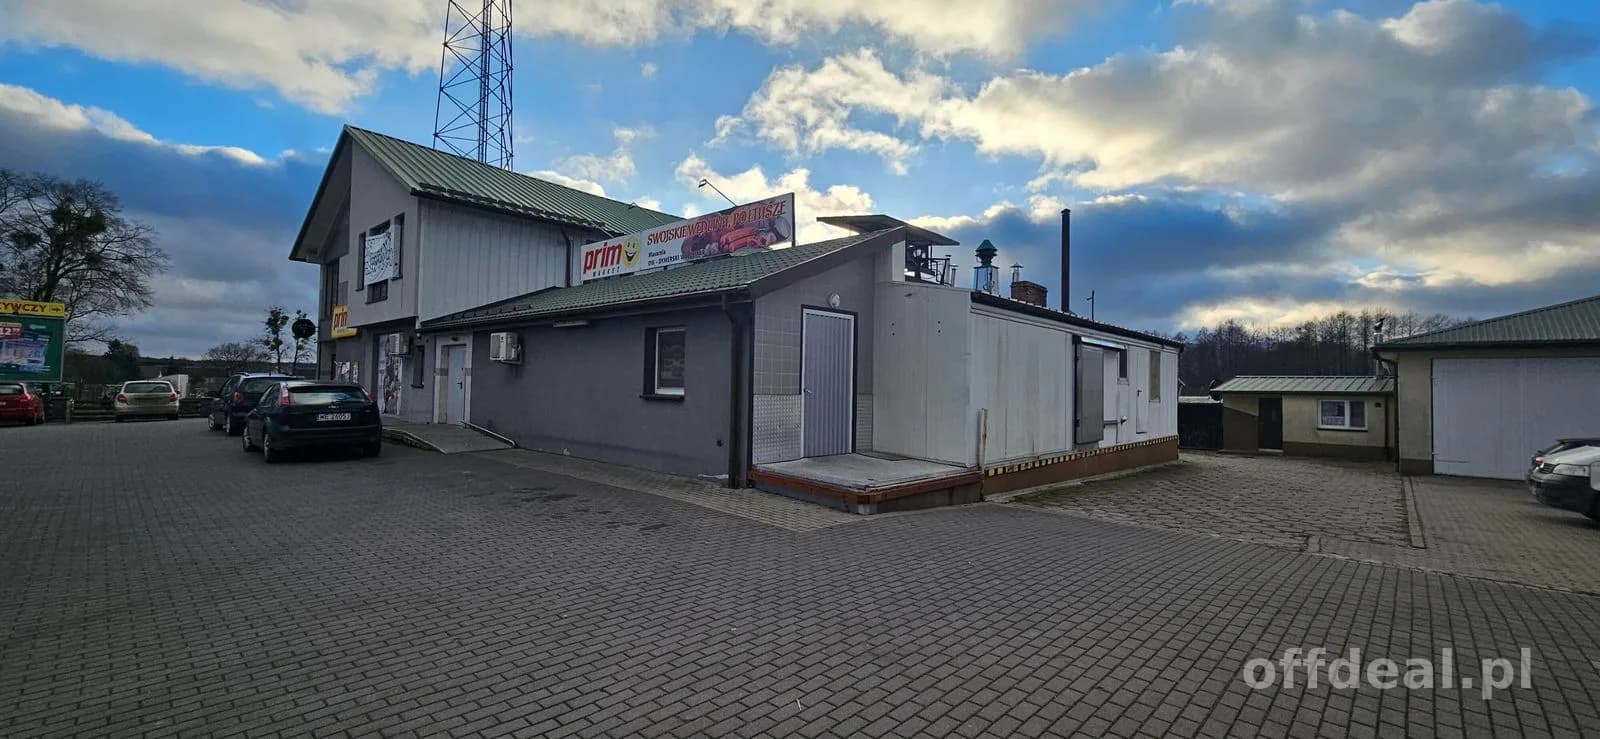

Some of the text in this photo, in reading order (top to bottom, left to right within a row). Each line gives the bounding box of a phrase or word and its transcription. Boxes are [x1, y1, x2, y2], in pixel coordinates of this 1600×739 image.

[647, 225, 688, 245] SWOJSKIE
[583, 242, 622, 274] prim
[593, 266, 620, 277] MARKET
[0, 302, 47, 312] YWCZY
